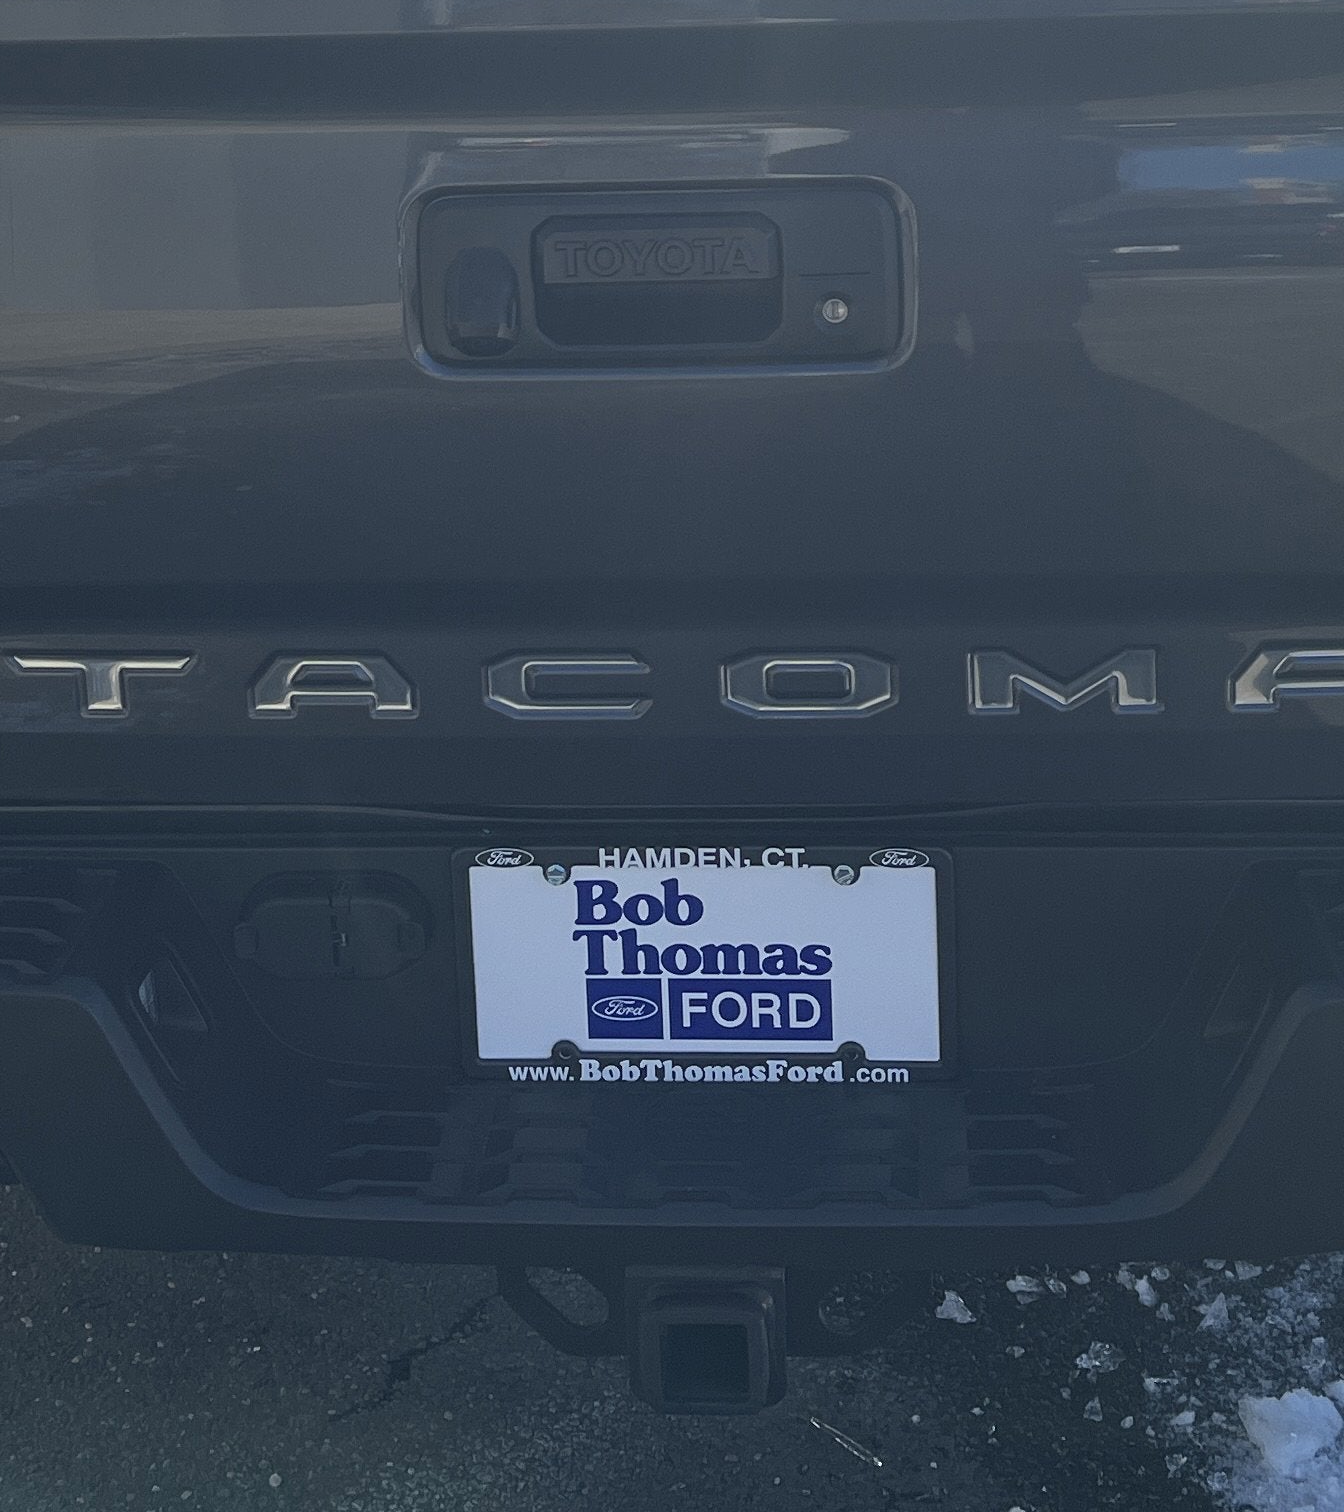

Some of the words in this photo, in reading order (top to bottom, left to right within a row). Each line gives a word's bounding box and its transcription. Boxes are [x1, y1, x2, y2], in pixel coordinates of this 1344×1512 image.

[555, 236, 759, 277] TOYOTA
[486, 850, 522, 867] Ford
[599, 847, 752, 869] HAMDEN,
[761, 847, 809, 869] CT.
[881, 850, 918, 867] Ford
[573, 877, 704, 926] Bob
[572, 928, 833, 976] Thomas
[604, 999, 646, 1018] Ford
[681, 991, 822, 1029] FORD
